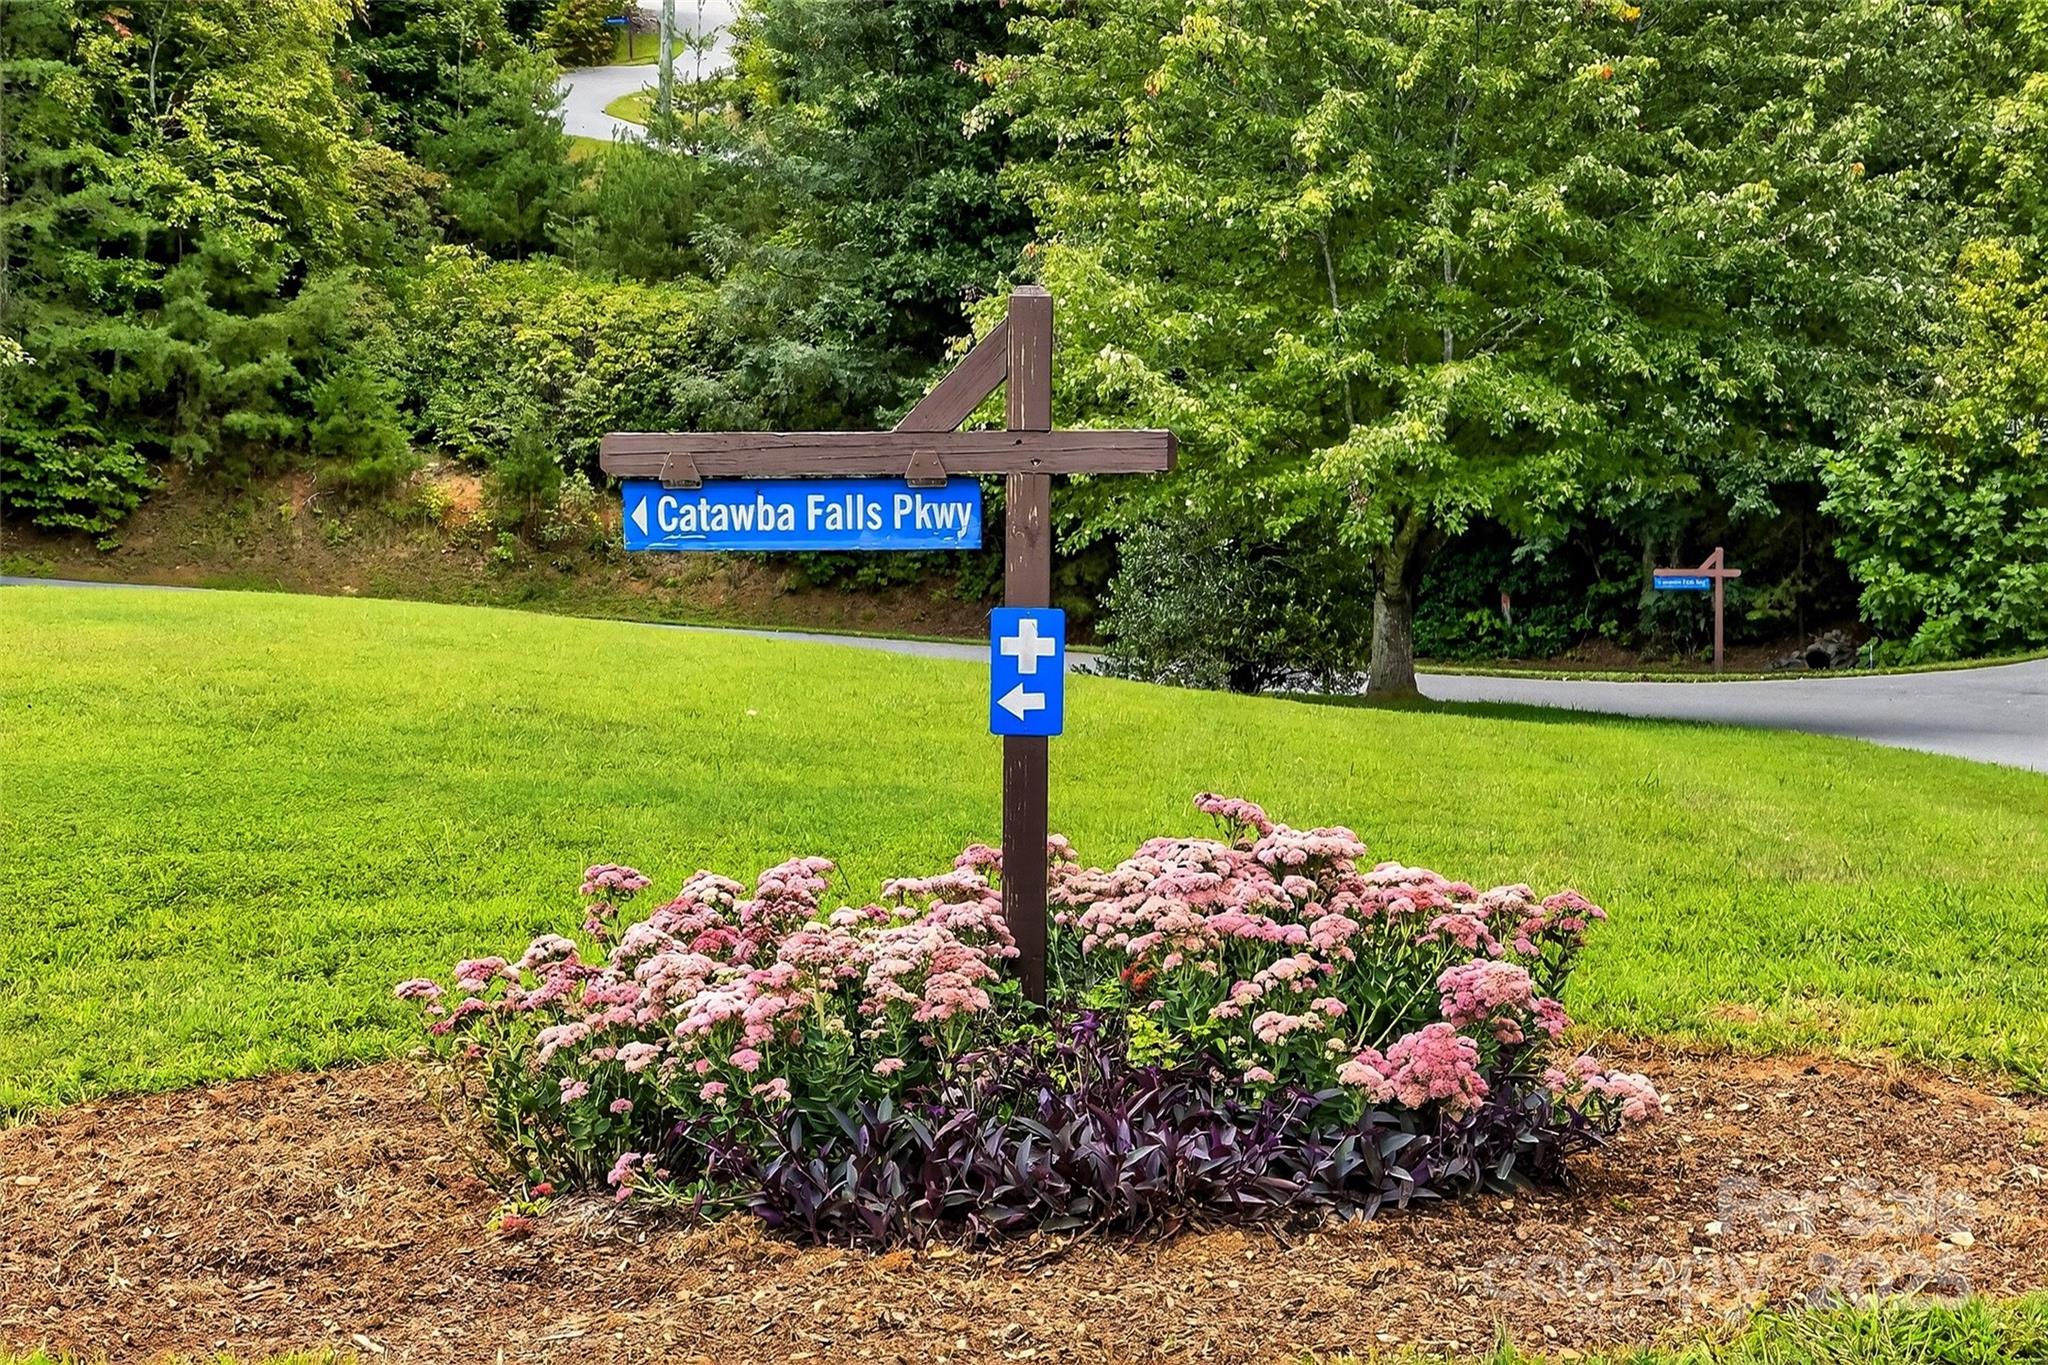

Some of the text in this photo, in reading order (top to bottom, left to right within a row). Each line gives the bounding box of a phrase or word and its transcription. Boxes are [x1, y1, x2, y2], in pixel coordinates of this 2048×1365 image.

[657, 493, 973, 540] Catawba Falls Pkwy
